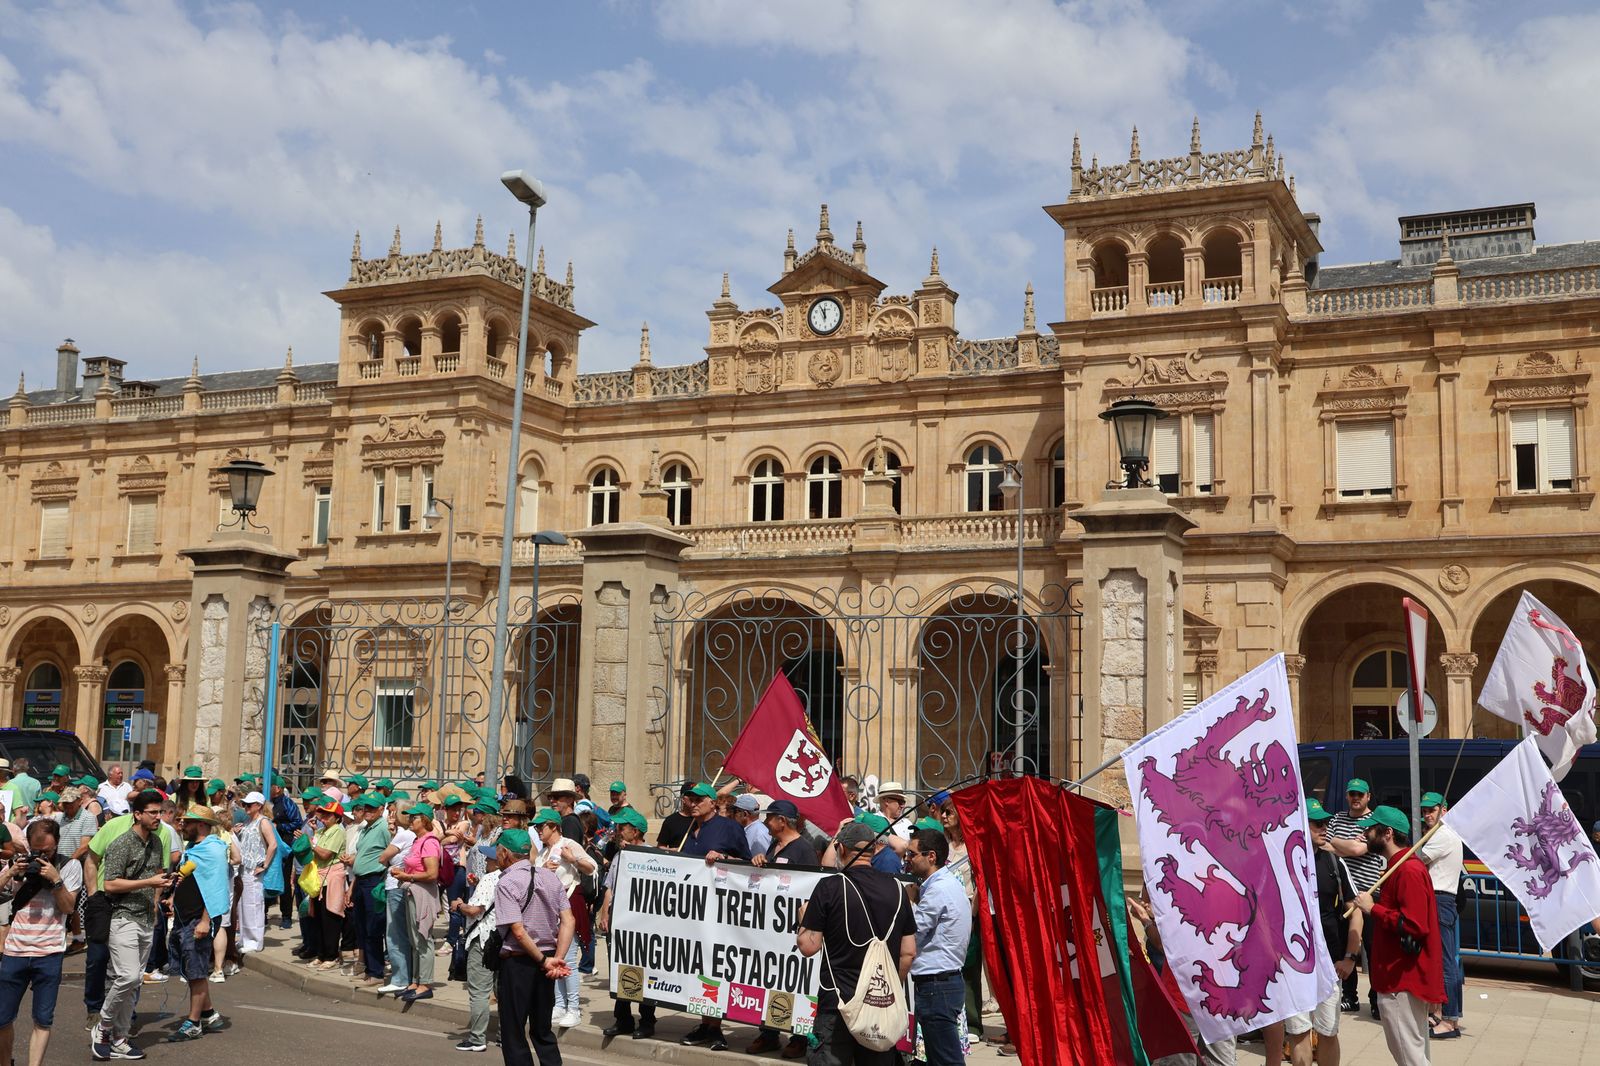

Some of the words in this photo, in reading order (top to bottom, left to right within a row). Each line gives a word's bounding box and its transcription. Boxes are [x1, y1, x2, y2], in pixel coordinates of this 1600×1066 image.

[28, 704, 59, 715] enterprise
[35, 718, 56, 726] National
[629, 874, 708, 921] NINGÚN
[715, 887, 767, 930] TREN
[614, 929, 704, 975] NINGUNA
[712, 943, 814, 995] ESTACIÓN
[647, 976, 682, 993] Futuro
[689, 996, 707, 1004] ahora
[739, 996, 762, 1012] UPL
